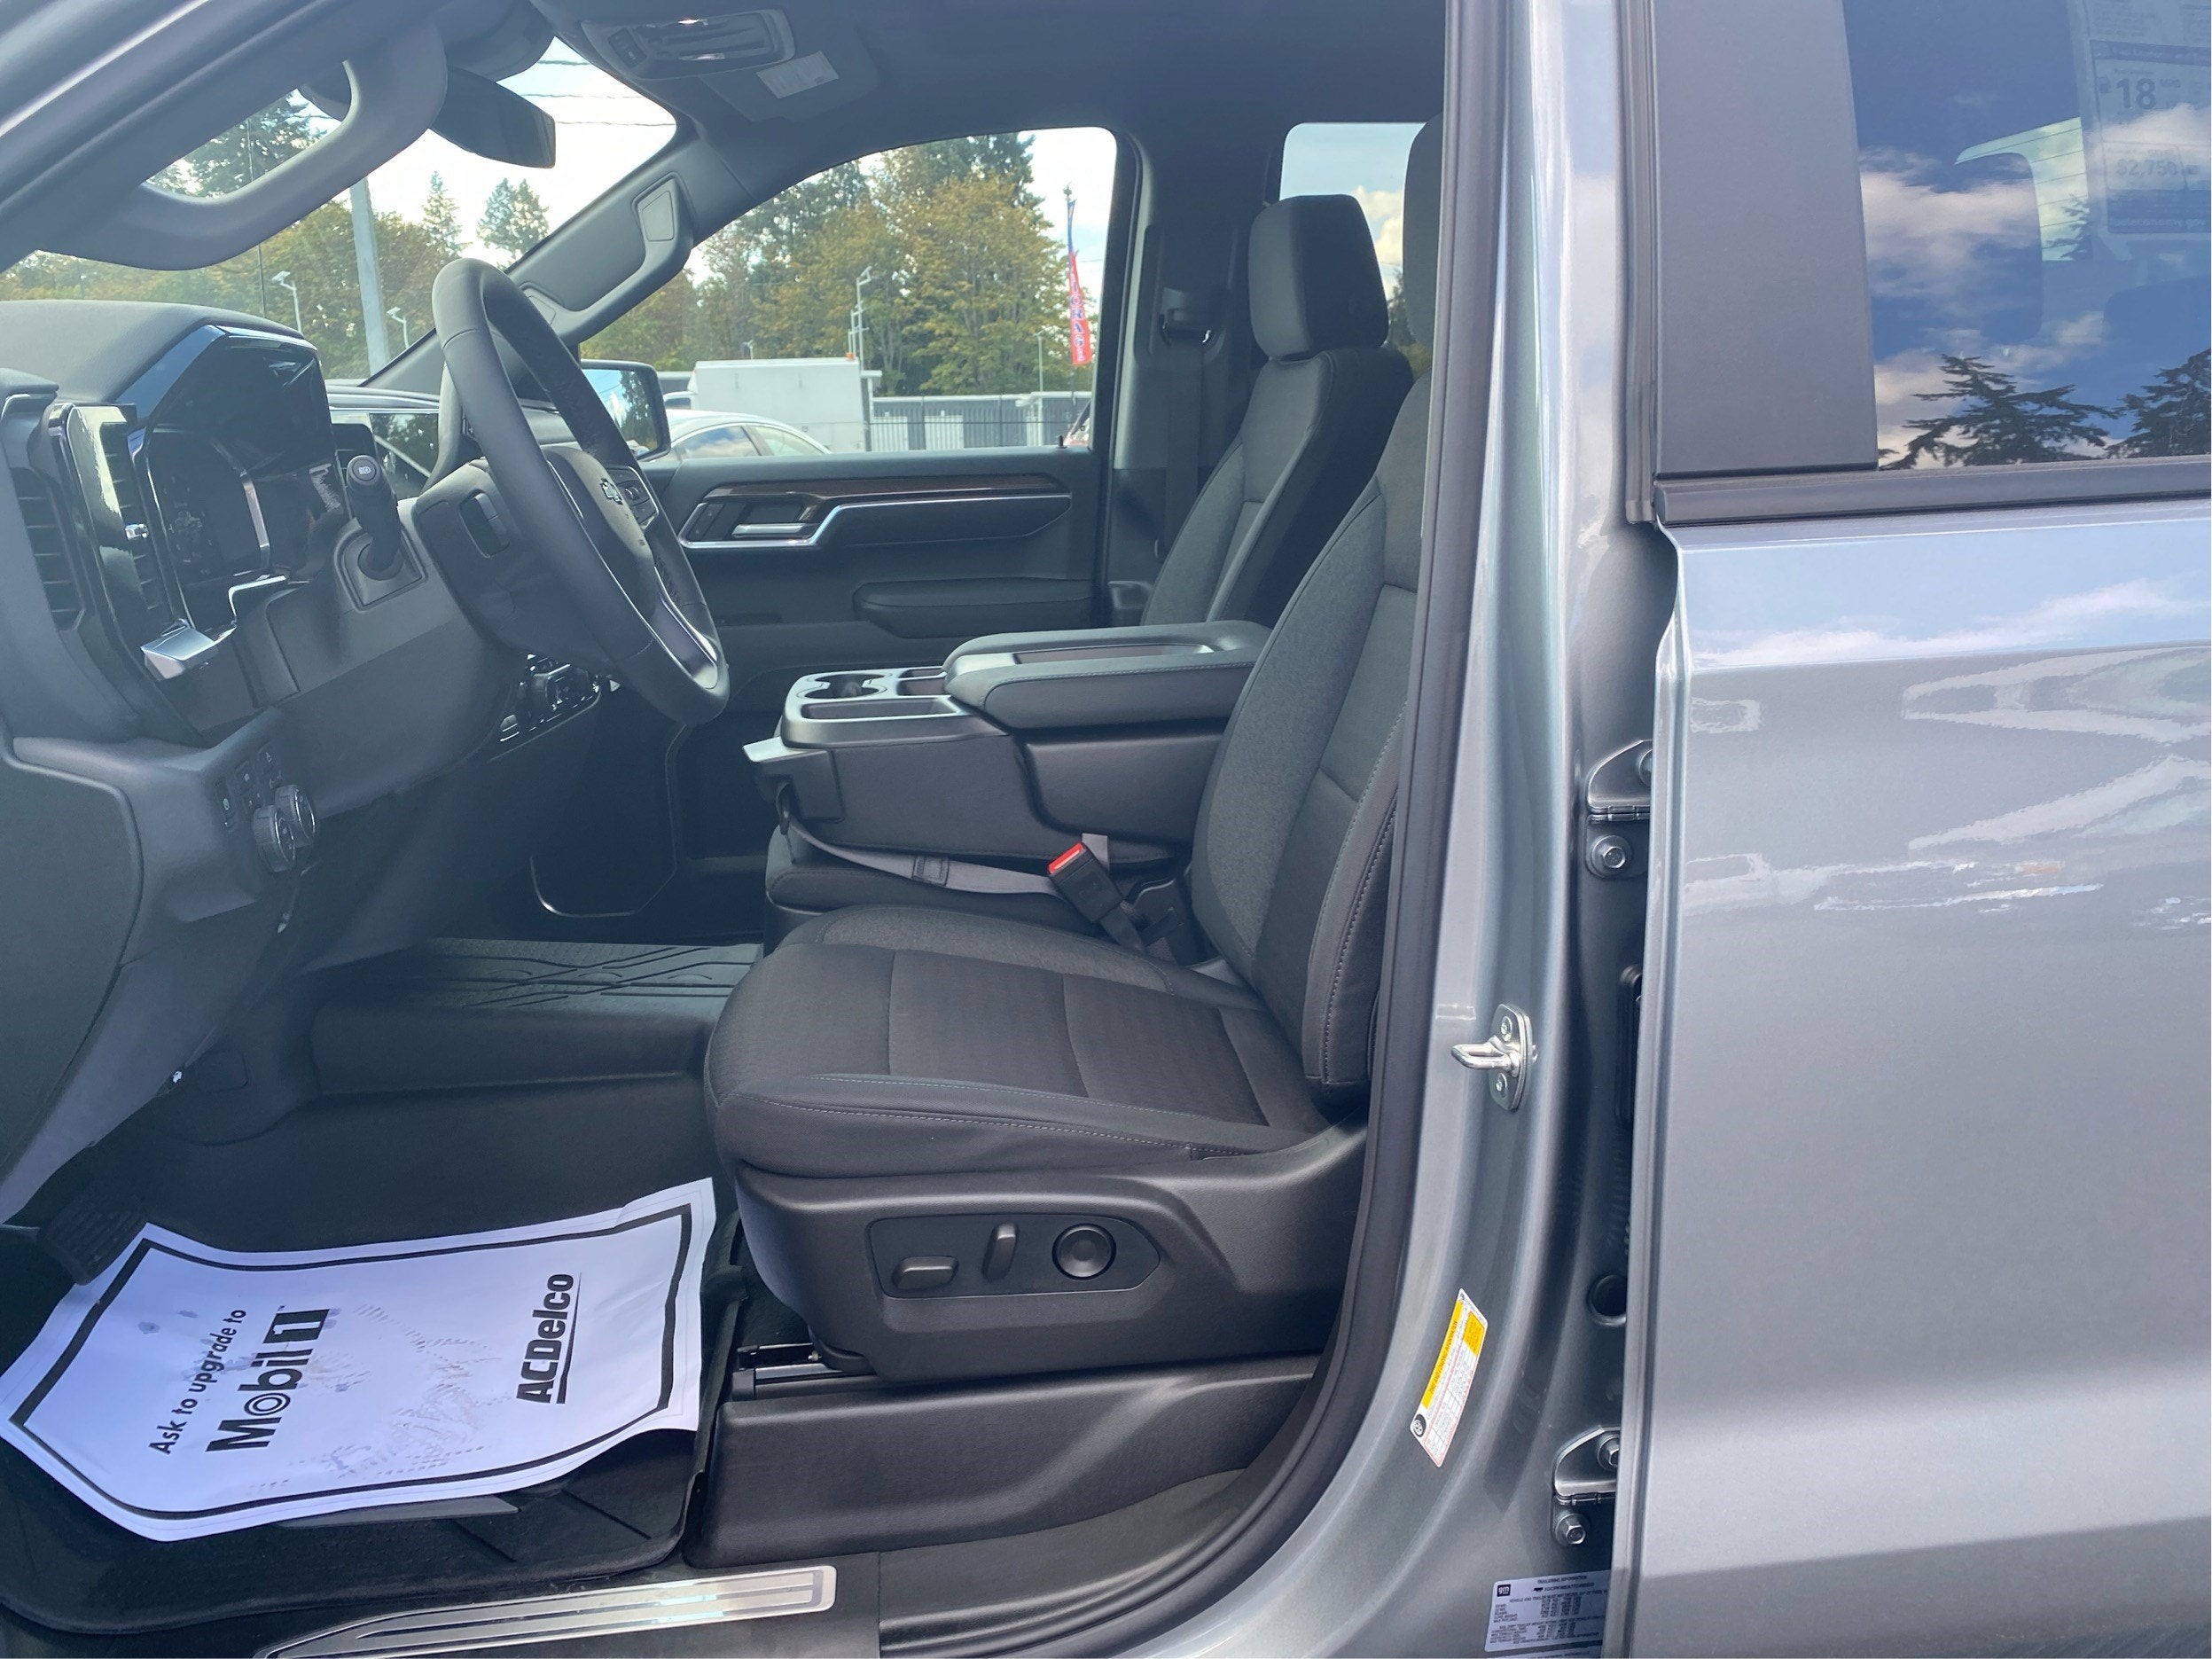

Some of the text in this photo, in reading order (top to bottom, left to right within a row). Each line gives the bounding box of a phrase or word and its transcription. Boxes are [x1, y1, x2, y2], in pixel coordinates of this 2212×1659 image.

[2116, 77, 2157, 110] 18
[148, 1310, 246, 1455] Ask to upgrade to
[516, 1273, 574, 1404] ACDelco
[205, 1348, 313, 1452] Mobil
